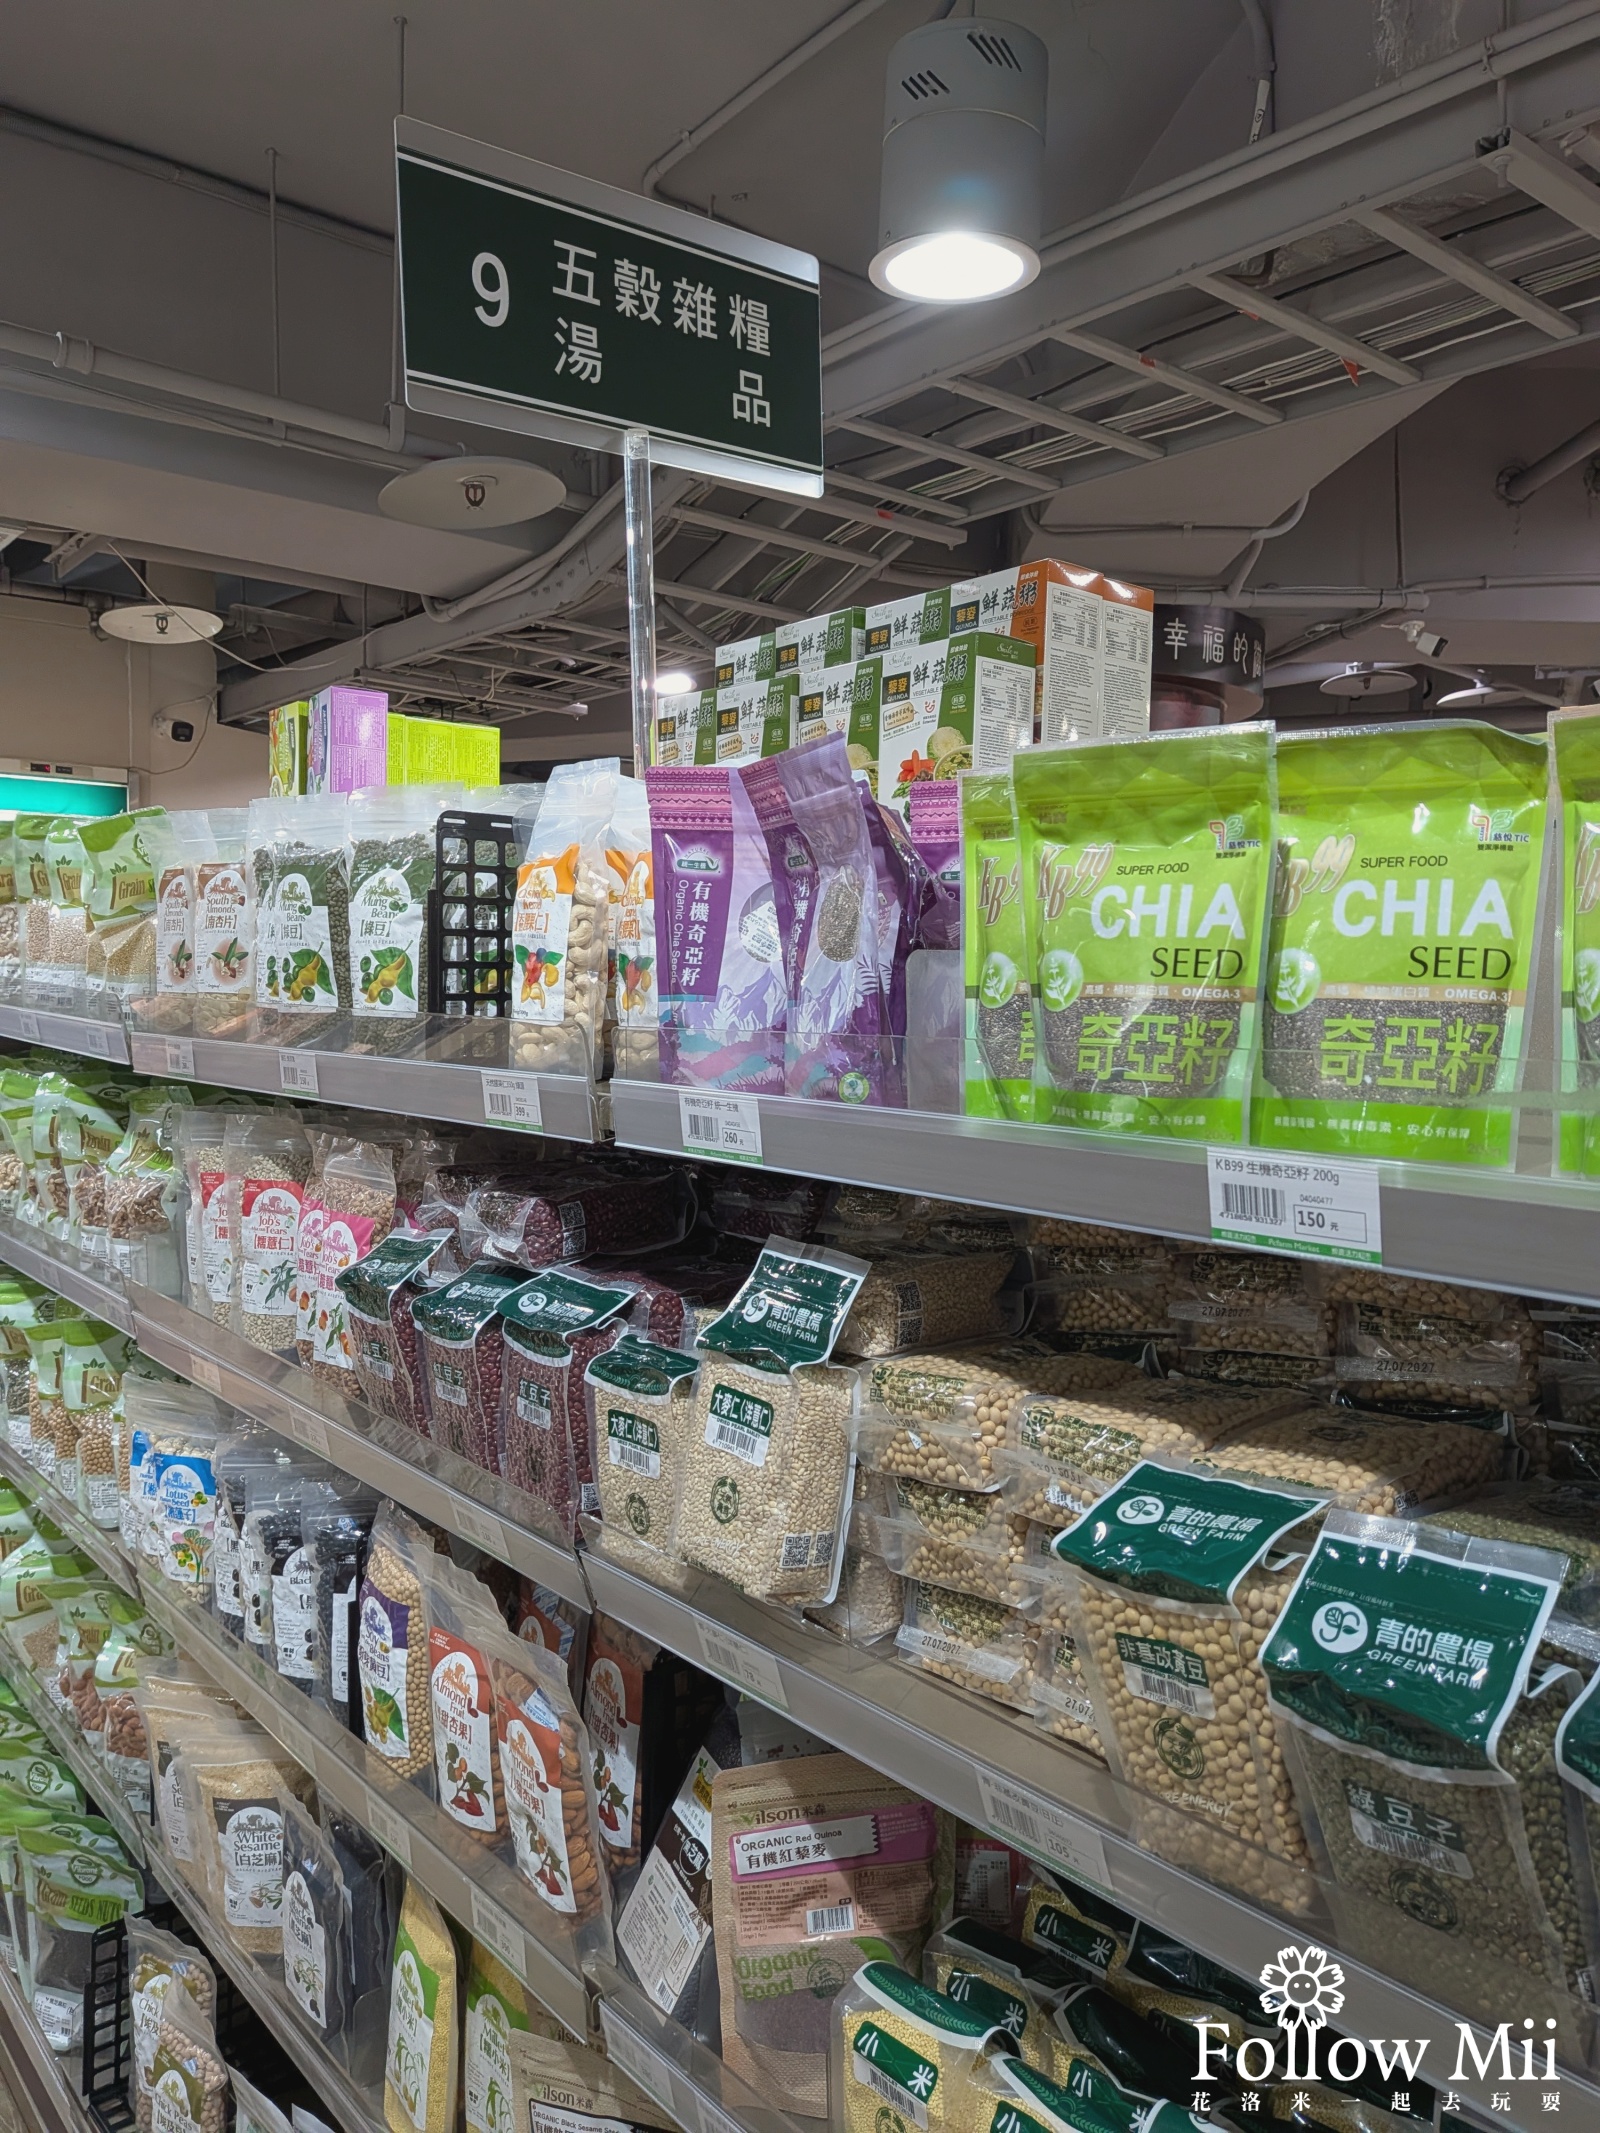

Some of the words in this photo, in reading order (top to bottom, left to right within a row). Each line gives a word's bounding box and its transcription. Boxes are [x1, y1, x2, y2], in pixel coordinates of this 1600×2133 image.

[471, 251, 510, 328] 9
[552, 239, 771, 357] 五穀雜糧
[981, 580, 1038, 616] 鮮蔬粥
[892, 607, 943, 638] 鮮蔬粥
[956, 606, 977, 622] 藜麥
[800, 626, 845, 656] 鮮蔬粥
[870, 630, 889, 645] 藜麥
[735, 649, 774, 675] 鮮蔬粥
[780, 648, 796, 661] 藜麥
[718, 666, 732, 680] 藜麥
[911, 654, 968, 690] 鮮蔬粥
[825, 675, 874, 707] 鮮蔬粥
[888, 677, 908, 694] 藜麥
[740, 694, 784, 722] 鮮蔬粥
[803, 697, 822, 712] 藜麥
[677, 704, 714, 730] 鮮蔬粥
[721, 711, 737, 726] 藜麥
[1247, 840, 1261, 849] TIC
[1514, 834, 1530, 843] TIC
[1116, 864, 1154, 876] SUPER
[1156, 862, 1190, 875] FOOD
[1360, 856, 1405, 869] SUPER
[1408, 854, 1449, 868] FOOD
[118, 879, 146, 900] Grain
[206, 896, 230, 905] South
[675, 879, 690, 922] Organic
[206, 905, 236, 914] Almonds
[361, 896, 388, 909] Mung
[1091, 883, 1247, 940] CHIA
[1332, 878, 1514, 940] CHIA
[673, 923, 684, 948] Chia
[680, 880, 713, 988] 有機奇亞籽
[1150, 947, 1244, 980] SEED
[1408, 945, 1512, 981] SEED
[1181, 987, 1241, 999] OMEGA-3
[1444, 987, 1509, 1002] OMEGA-3
[1077, 1011, 1234, 1086] 奇亞籽
[1320, 1013, 1500, 1096] 奇亞籽
[724, 1131, 738, 1144] 260
[1215, 1158, 1243, 1173] KB99
[1246, 1162, 1310, 1181] 生機奇亞籽
[1313, 1169, 1340, 1186] 200g
[259, 1215, 281, 1227] Job's
[266, 1226, 288, 1235] Tears
[1297, 1210, 1325, 1229] 150
[1330, 1221, 1339, 1232] 元
[766, 1319, 792, 1335] GREEN
[795, 1329, 818, 1344] FARM
[518, 1378, 551, 1409] 紅豆子
[165, 1487, 189, 1501] Lotus
[1165, 1505, 1263, 1533] 青的農場
[1158, 1523, 1201, 1537] GREEN
[1208, 1528, 1247, 1542] FARM
[1375, 1616, 1494, 1670] 青的農場
[1118, 1638, 1207, 1683] 非基改黃豆
[1368, 1649, 1428, 1675] GREEN
[433, 1678, 468, 1711] Almond
[450, 1700, 466, 1722] Fruit
[1347, 1783, 1457, 1844] 綠豆子
[233, 1840, 281, 1852] Sesame
[238, 1831, 276, 1844] White
[740, 1835, 793, 1852] ORGANIC
[795, 1833, 812, 1844] Red
[814, 1829, 843, 1841] Quinoa
[1048, 1838, 1070, 1858] 105
[232, 1851, 283, 1868] 【白芝麻】
[746, 1843, 828, 1869] 有機紅藜麥
[68, 1895, 97, 1919] SEEDS
[857, 2030, 933, 2097] 小米
